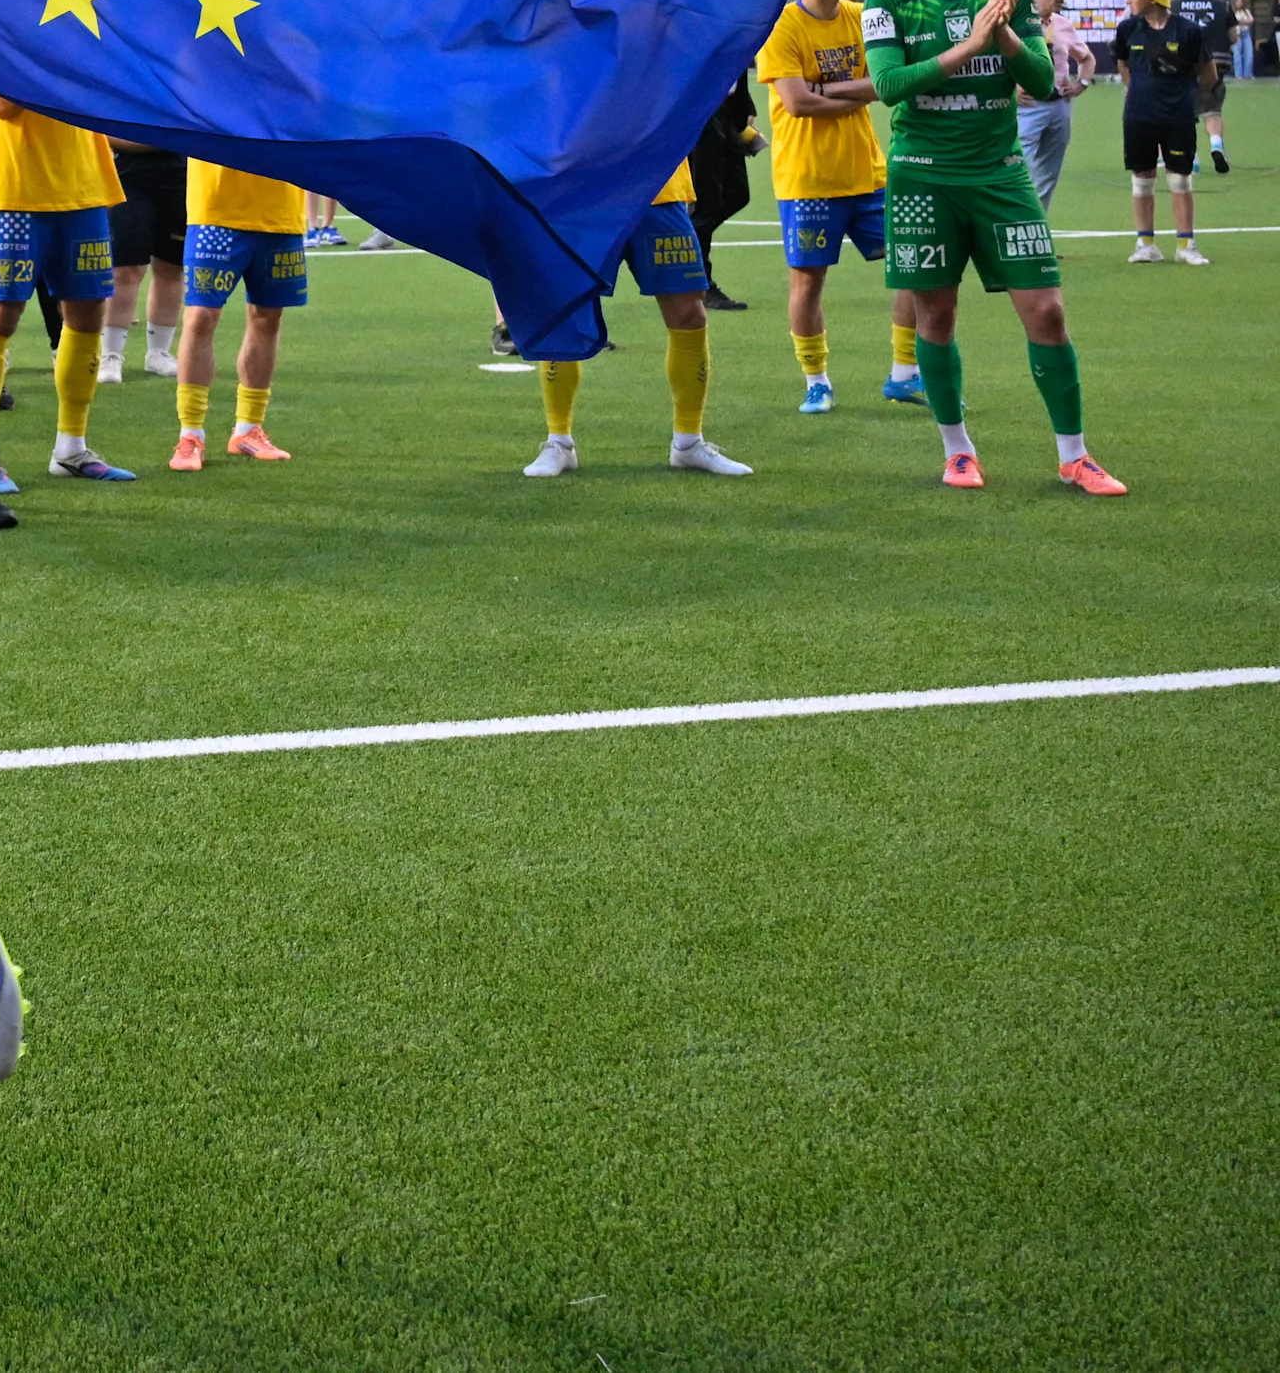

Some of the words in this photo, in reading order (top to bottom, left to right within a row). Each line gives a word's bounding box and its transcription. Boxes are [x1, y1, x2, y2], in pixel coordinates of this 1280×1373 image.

[1181, 0, 1213, 11] MEDIA
[903, 31, 937, 45] apanet
[814, 43, 860, 62] EUROPE
[818, 58, 844, 72] HERE
[846, 54, 861, 69] WE
[815, 228, 828, 249] 6
[893, 227, 937, 236] SEPTENI
[1005, 223, 1049, 242] PAULI
[80, 241, 110, 257] PAULI
[655, 235, 694, 251] PAULI
[1005, 239, 1053, 257] BETON
[77, 256, 113, 271] BETON
[274, 250, 303, 265] PAULI
[654, 249, 697, 265] BETON
[919, 243, 947, 270] 21
[14, 259, 35, 283] 23
